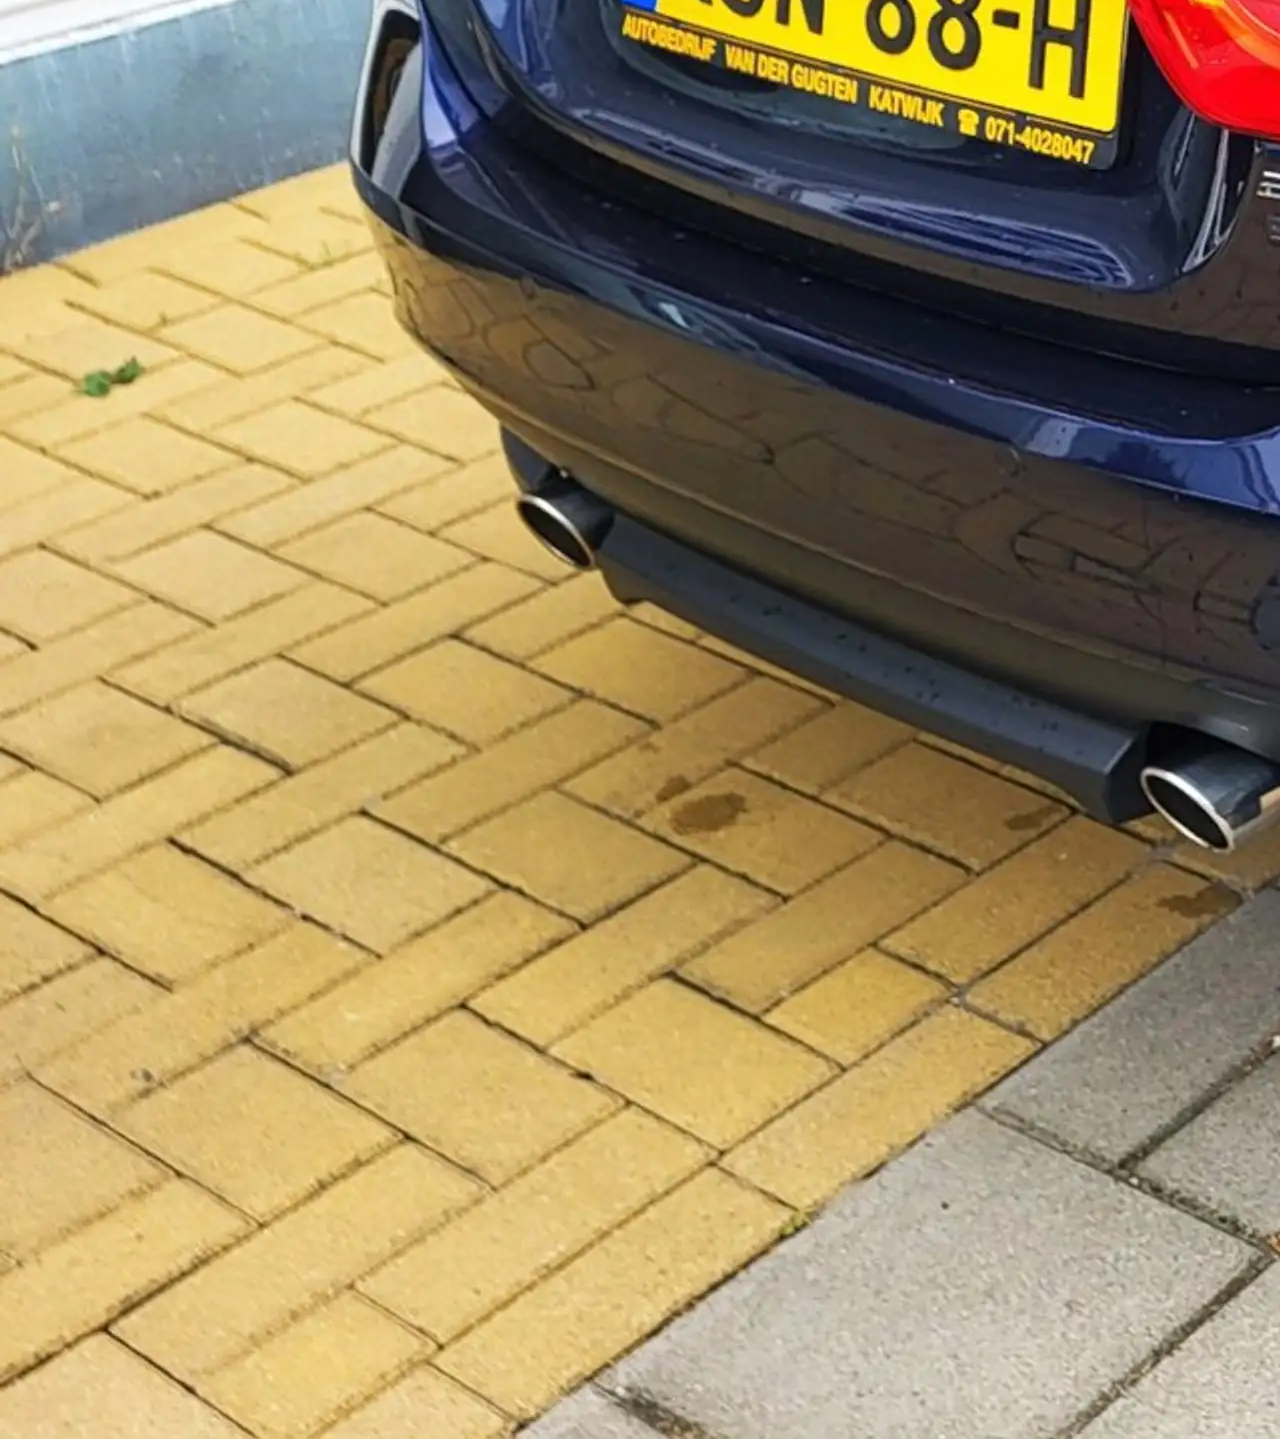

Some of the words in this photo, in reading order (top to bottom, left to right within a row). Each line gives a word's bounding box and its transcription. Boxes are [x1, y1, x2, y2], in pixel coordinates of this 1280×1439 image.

[622, 14, 717, 62] AUTOBEDRIJF
[725, 42, 755, 75] VAN
[757, 53, 789, 85] DER
[791, 64, 858, 104] GUGTEN
[868, 84, 945, 127] KATWIJK
[984, 118, 1095, 165] 071-4028047
